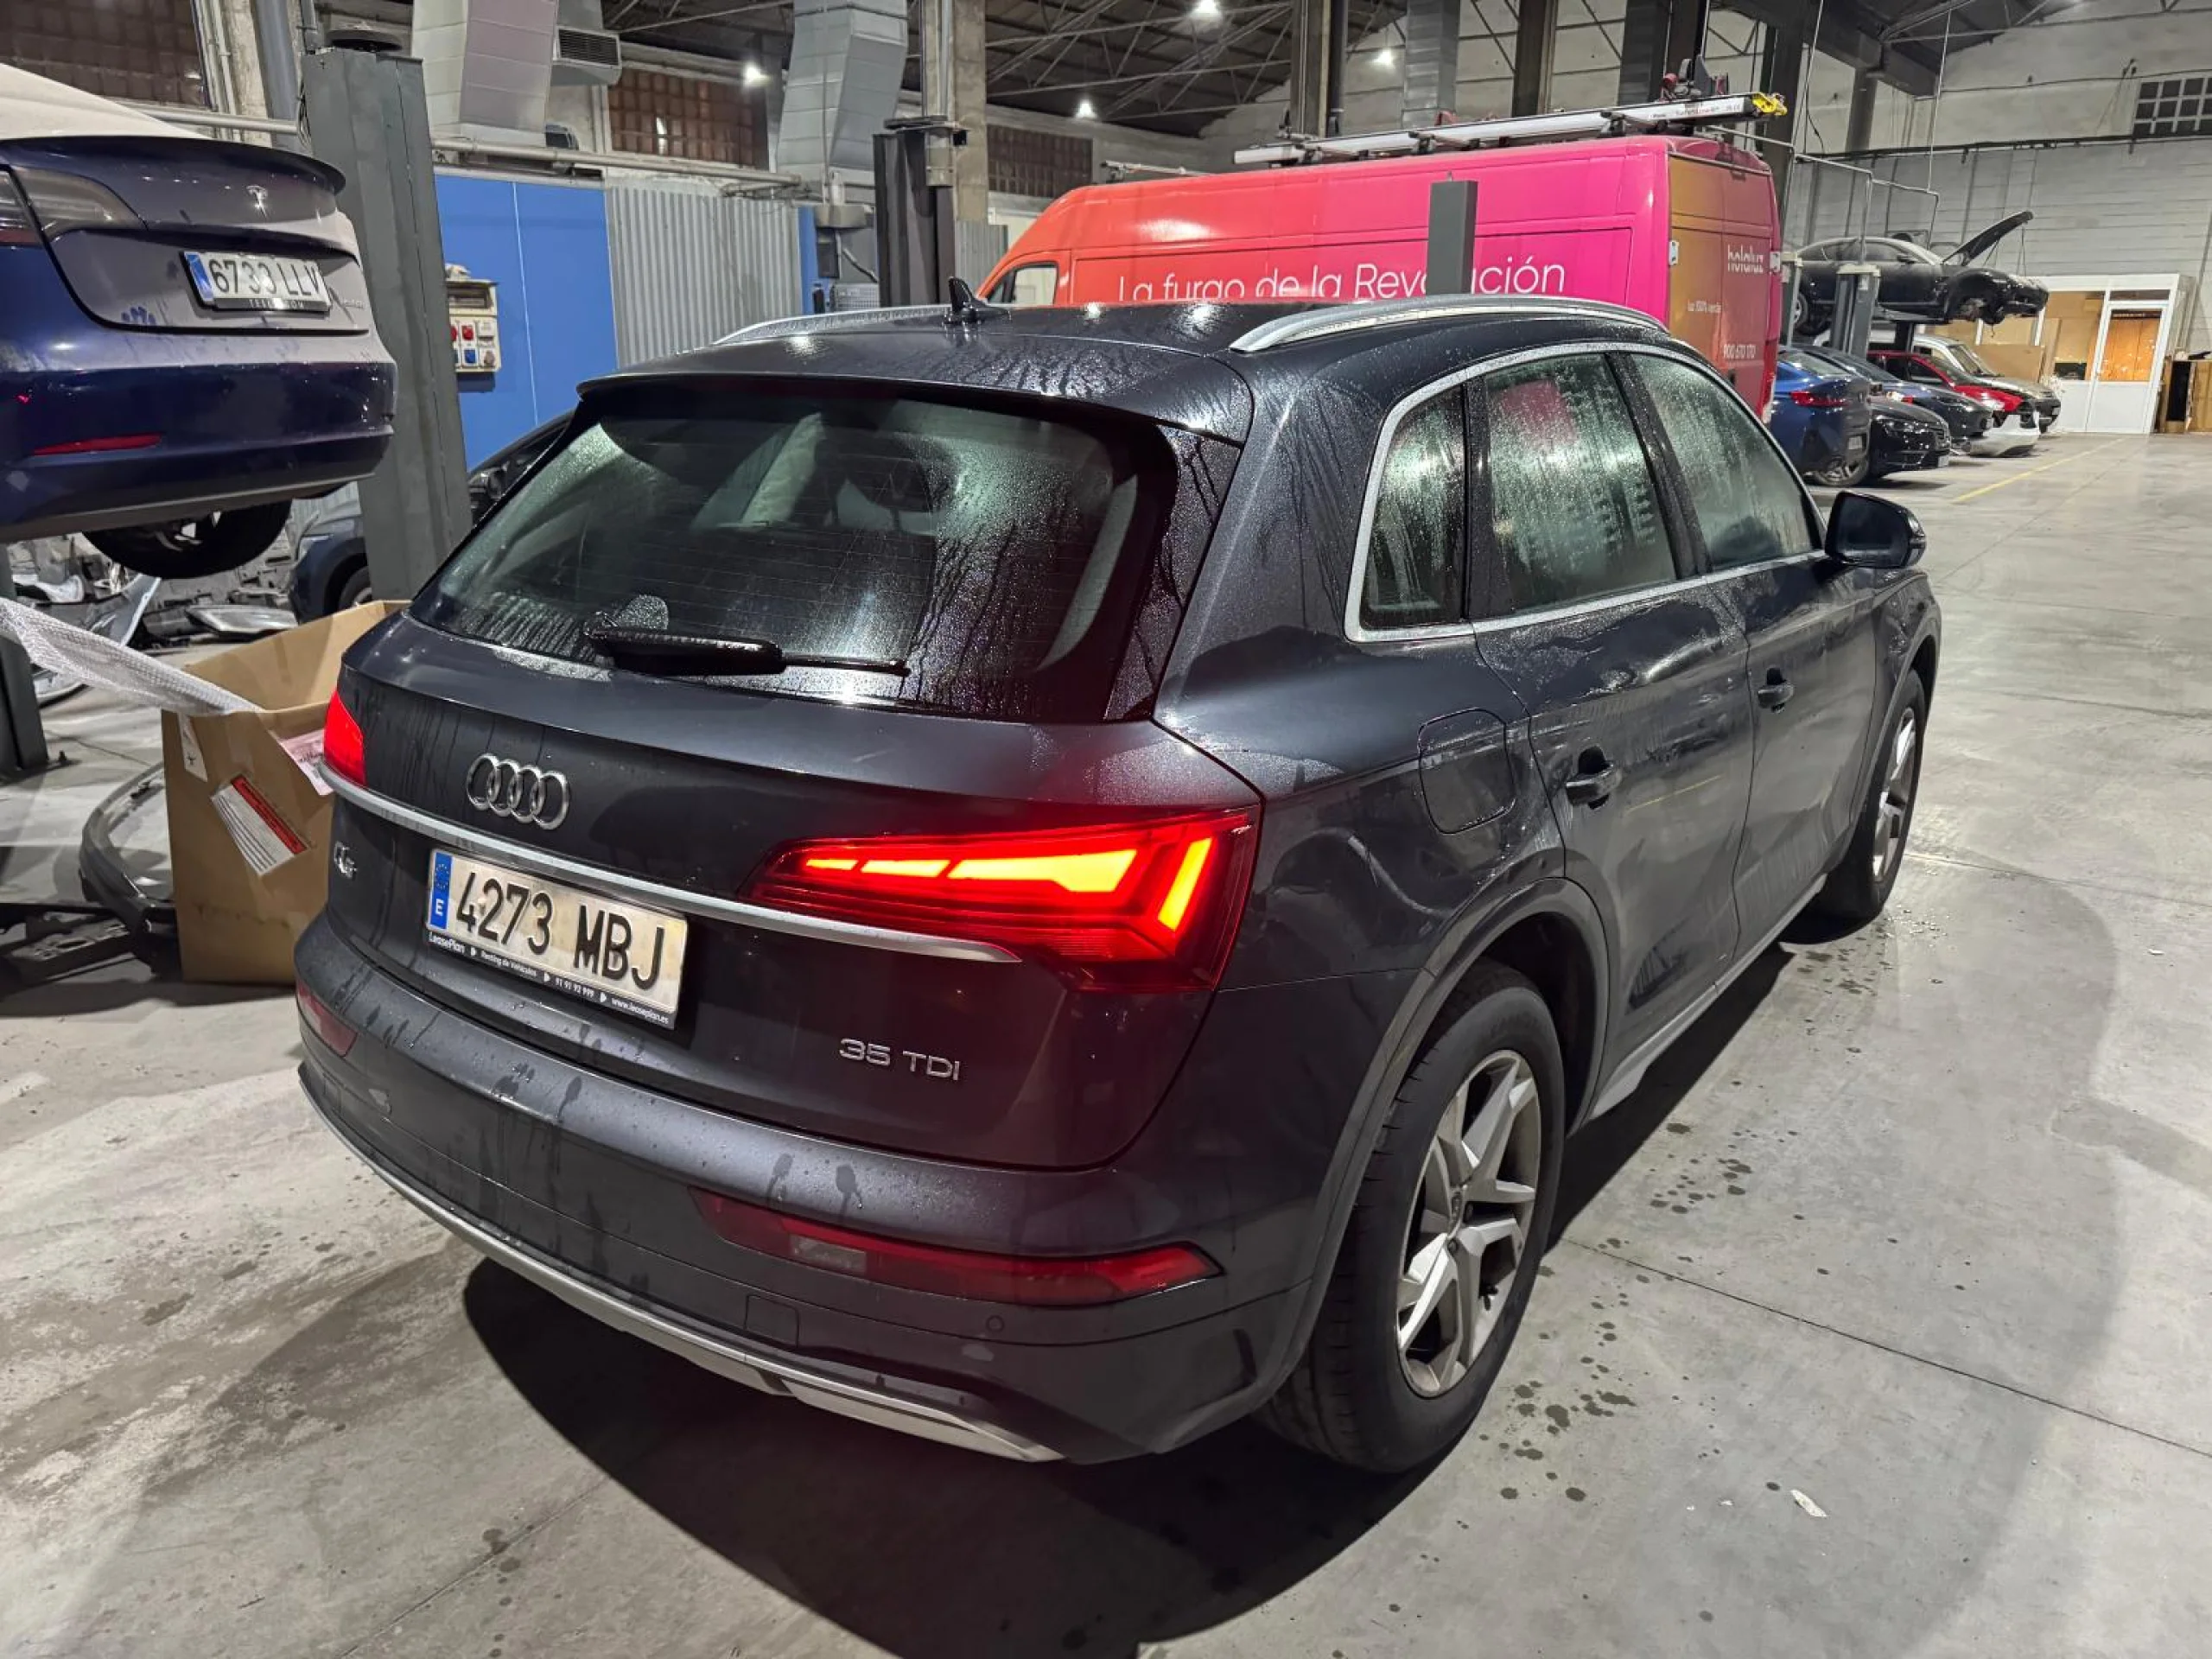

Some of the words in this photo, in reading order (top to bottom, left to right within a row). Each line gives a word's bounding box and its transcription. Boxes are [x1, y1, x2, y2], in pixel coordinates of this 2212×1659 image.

[208, 258, 276, 296] 6733
[276, 262, 321, 296] LLV
[1163, 271, 1245, 301] furgo
[1255, 267, 1300, 298] de
[1313, 264, 1342, 298] la
[1355, 256, 1566, 299] Revción
[435, 898, 444, 917] E
[456, 871, 555, 956] 4273
[573, 904, 665, 991] MBJ
[428, 931, 466, 955] LeasePlan
[480, 950, 502, 967] Renting
[610, 997, 670, 1025] www.leaseplan.es
[839, 1038, 891, 1066] 35
[902, 1050, 960, 1081] TDI
